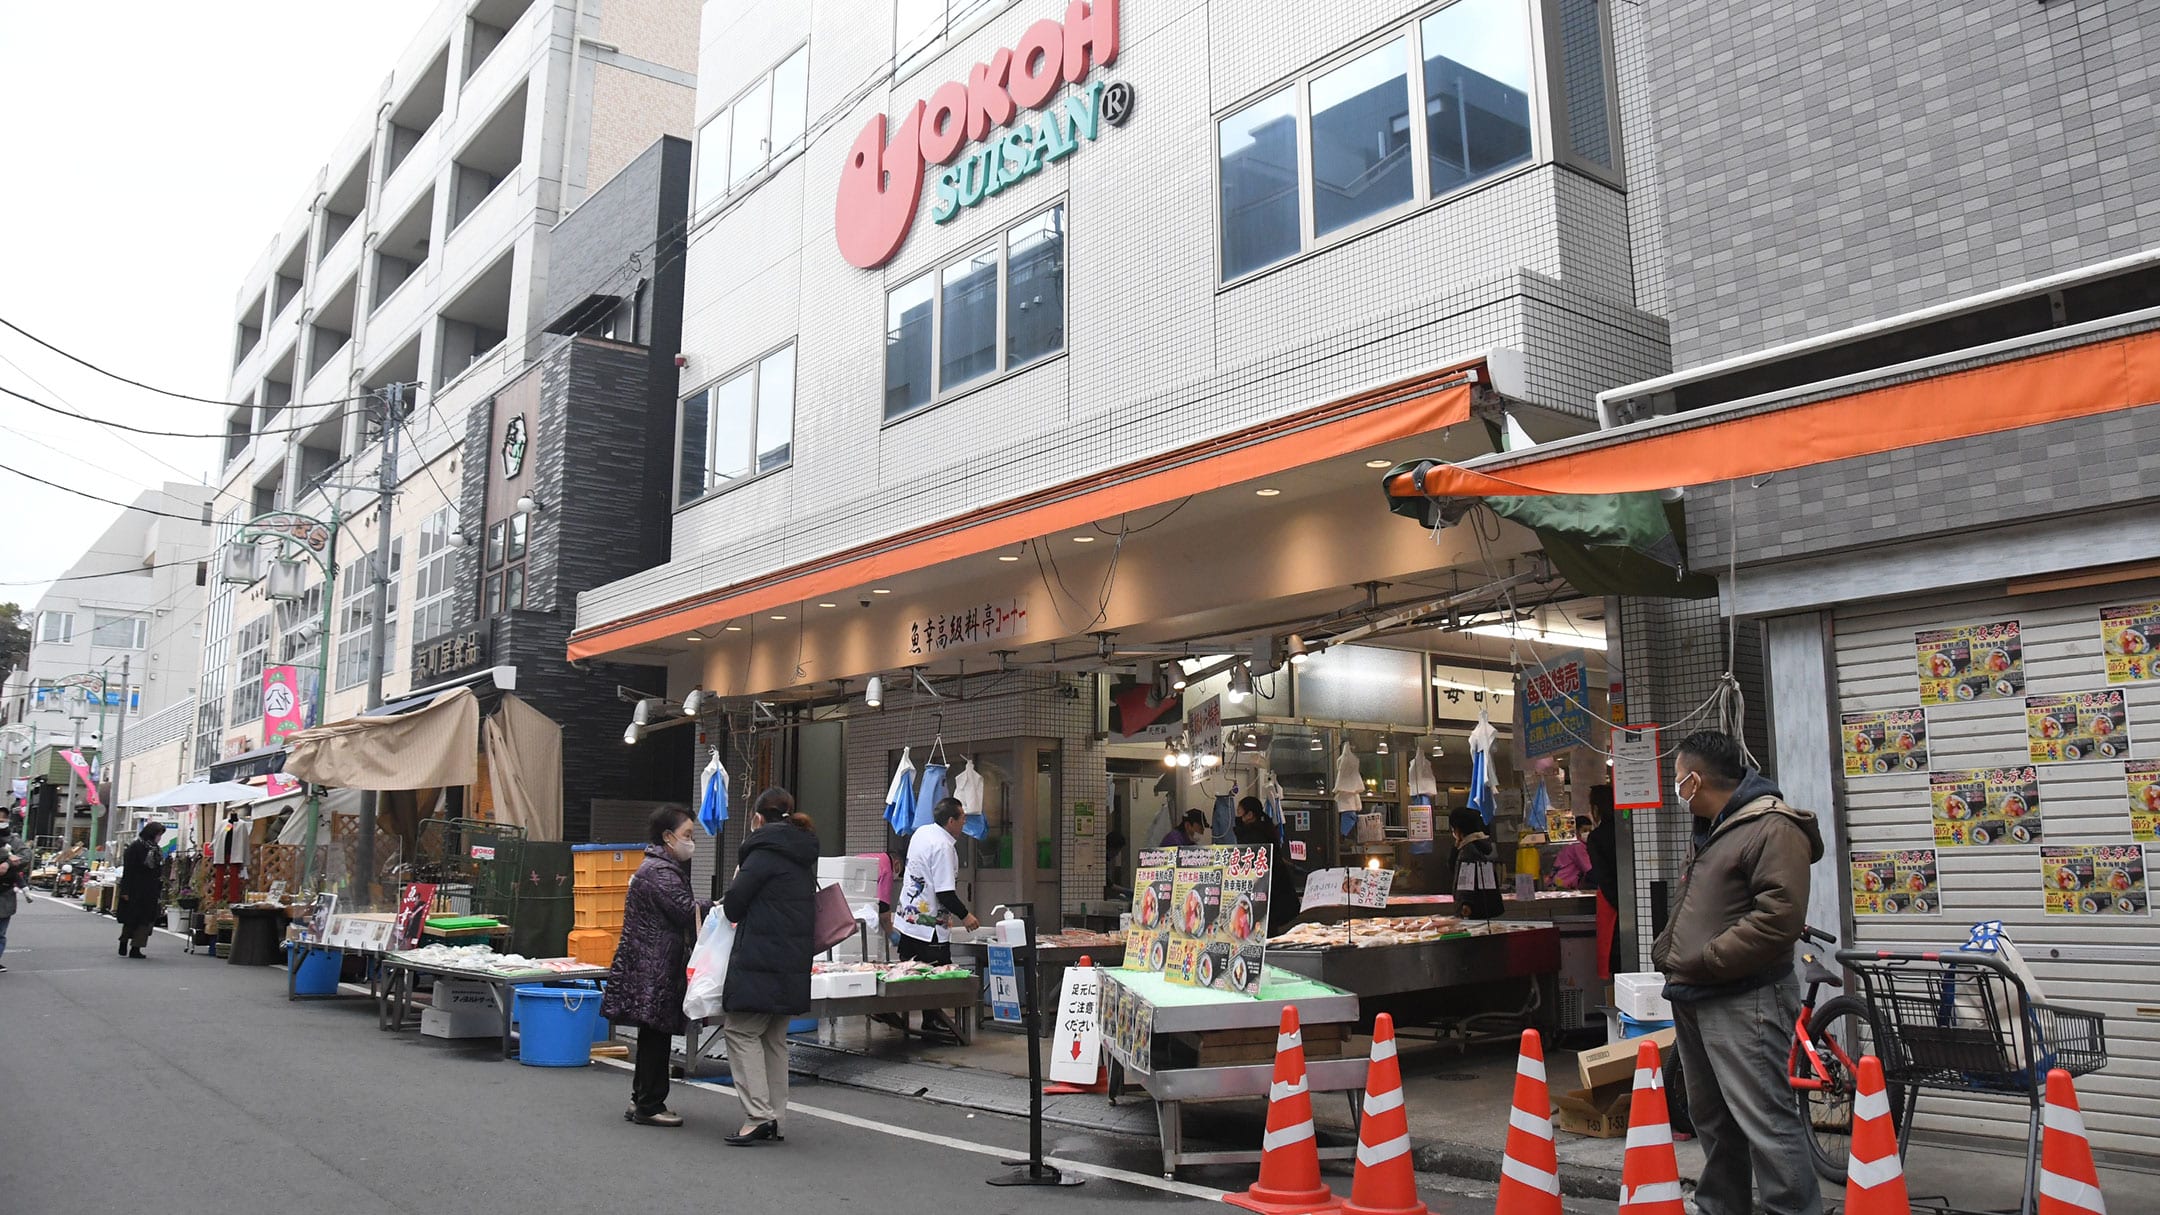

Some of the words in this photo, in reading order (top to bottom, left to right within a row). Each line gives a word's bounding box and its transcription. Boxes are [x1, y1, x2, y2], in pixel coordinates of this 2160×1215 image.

[836, 0, 1120, 268] YOKOH
[932, 81, 1104, 224] SUISAN
[1527, 662, 1580, 705] 毎朝特売
[615, 852, 621, 861] 3
[1227, 846, 1269, 878] 恵方巻
[1071, 983, 1097, 996] 足元に
[1069, 1002, 1095, 1015] ご注意
[1064, 1019, 1094, 1033] ください
